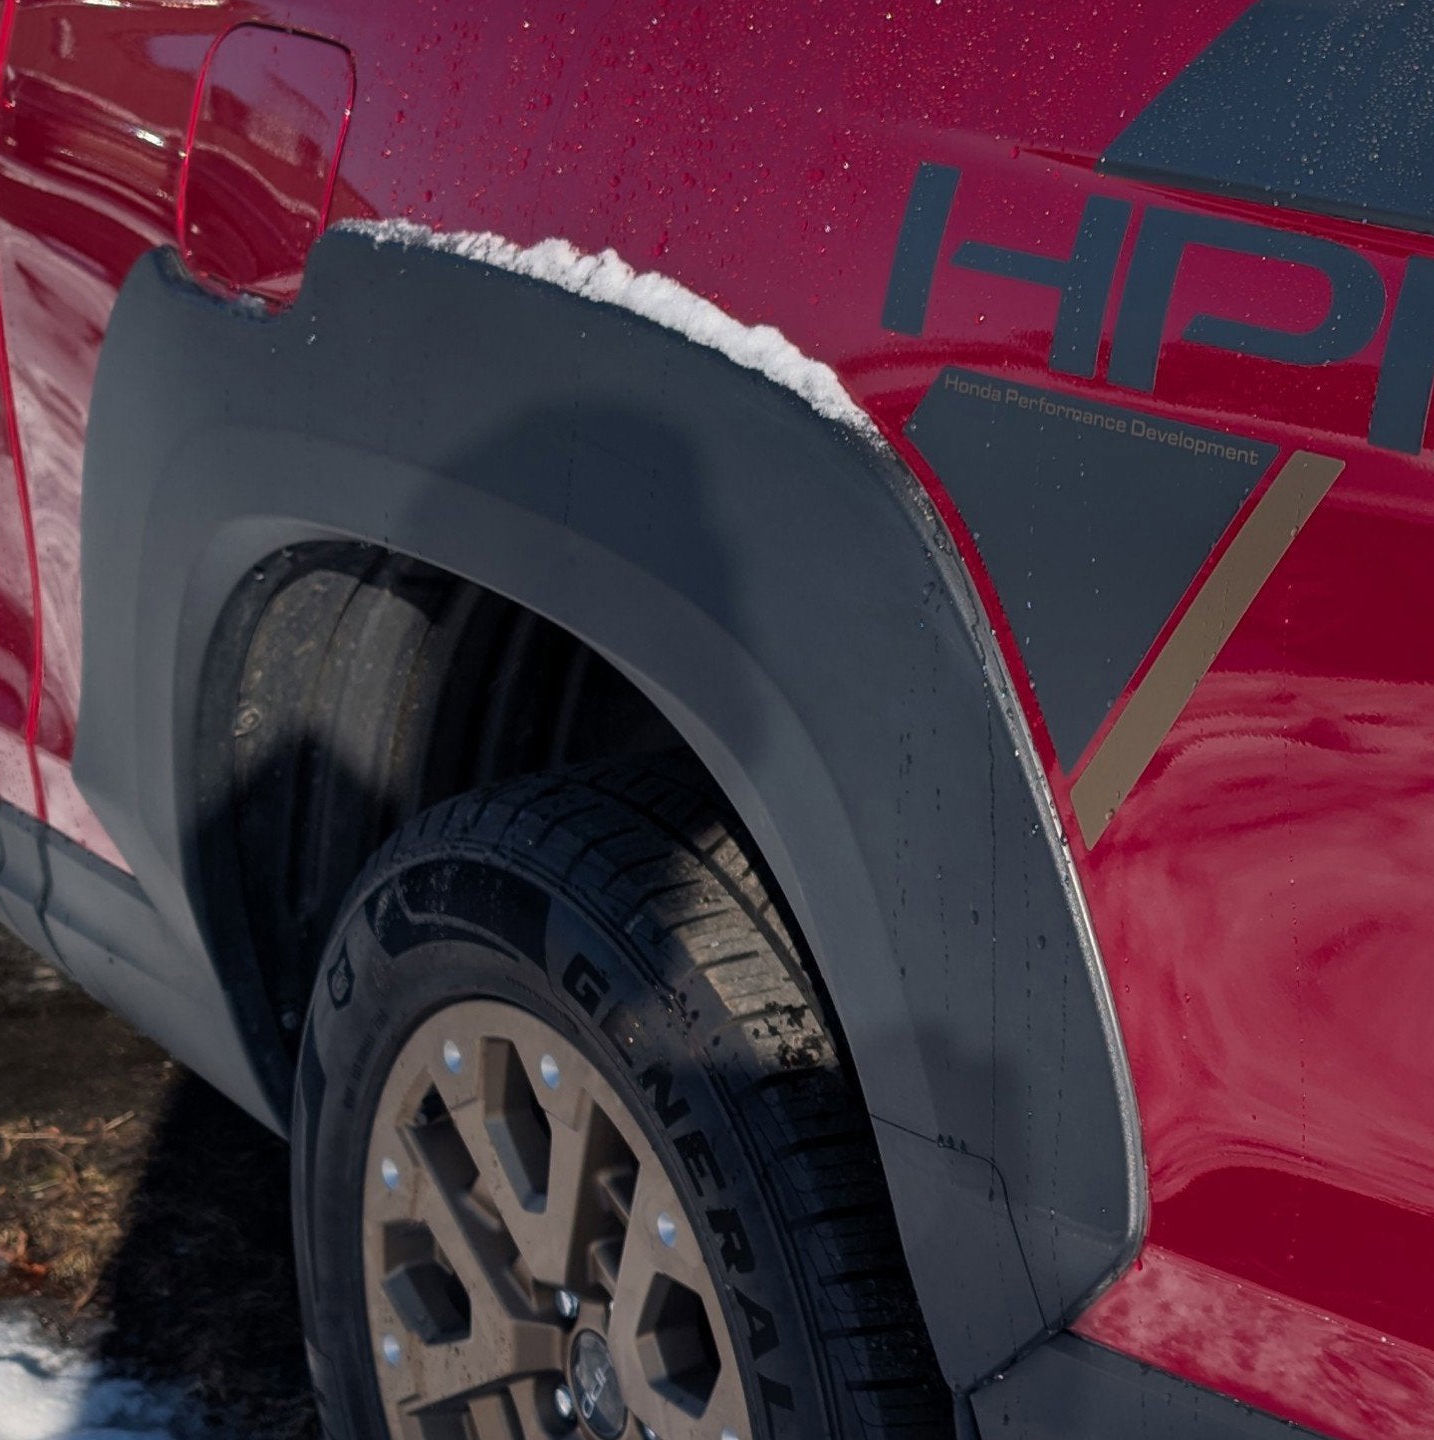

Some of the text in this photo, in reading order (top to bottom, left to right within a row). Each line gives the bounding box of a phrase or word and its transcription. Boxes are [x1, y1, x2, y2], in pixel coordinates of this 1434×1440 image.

[943, 373, 1261, 467] Honda Performance Development
